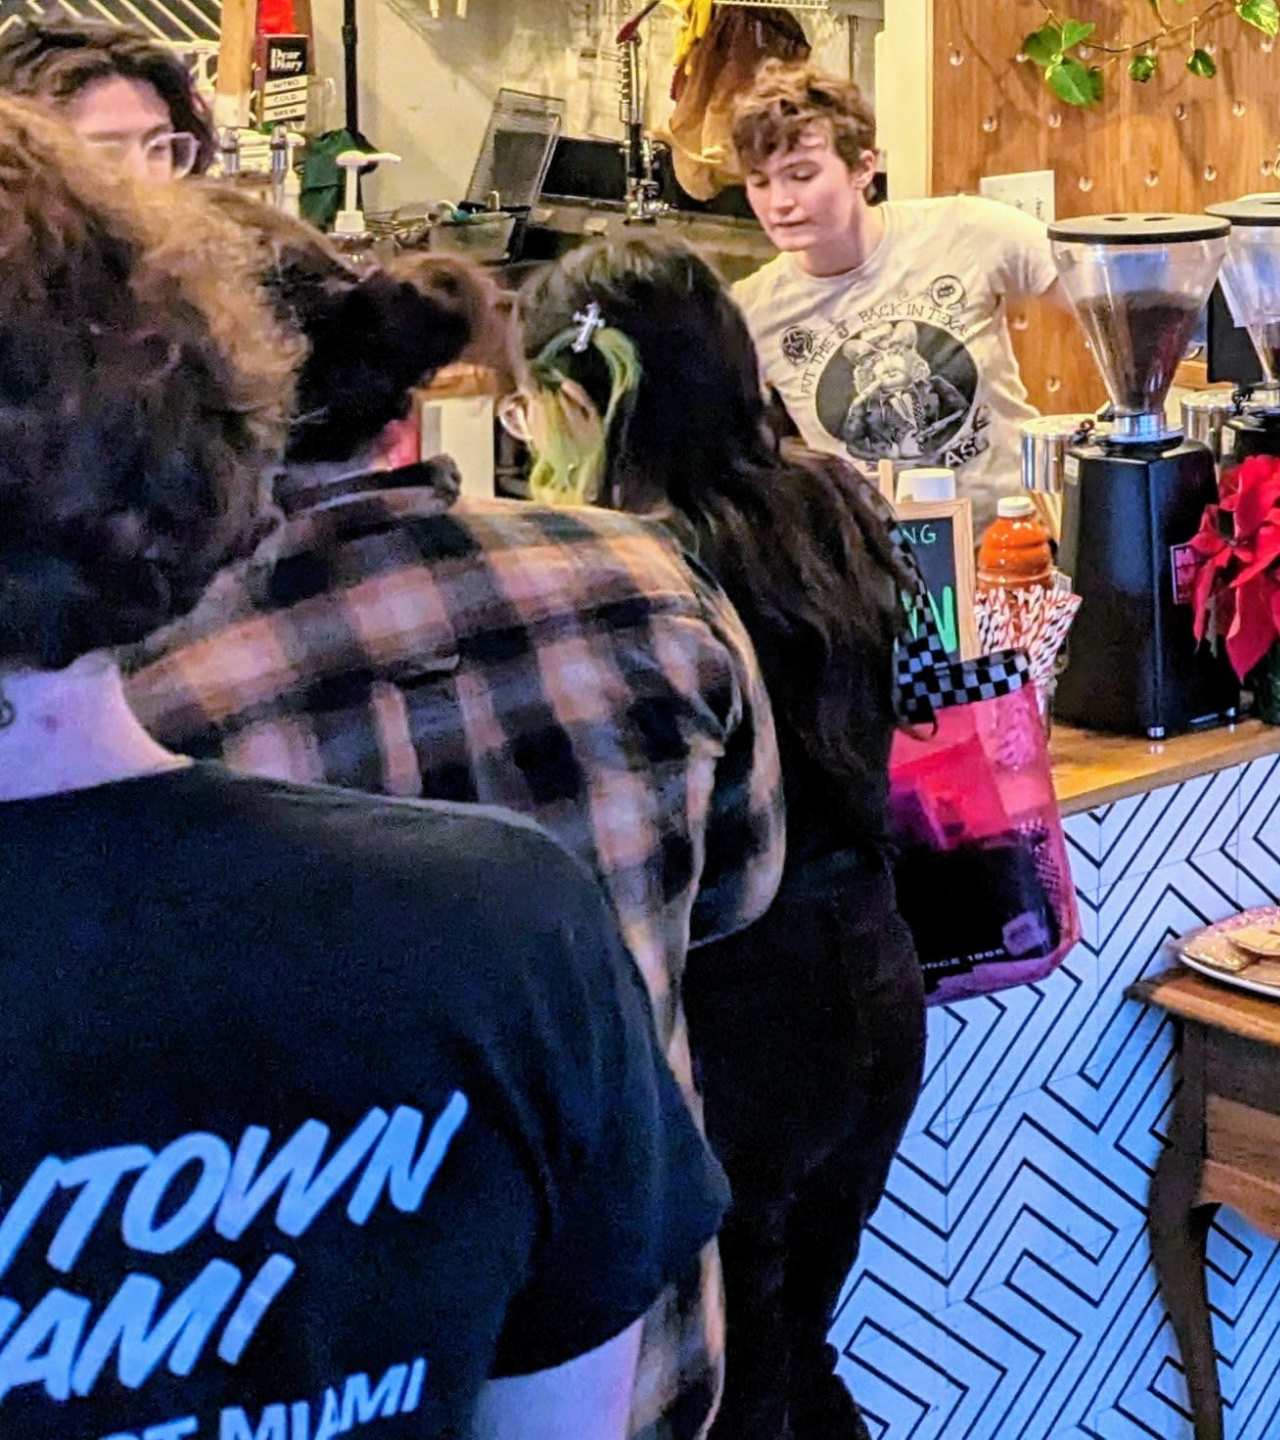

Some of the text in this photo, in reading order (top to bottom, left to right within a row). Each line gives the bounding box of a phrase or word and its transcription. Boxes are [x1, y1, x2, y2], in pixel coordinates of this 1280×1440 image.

[270, 48, 301, 61] Dear
[270, 58, 304, 72] Diary
[811, 338, 835, 366] THE
[858, 302, 901, 324] BACK
[906, 302, 924, 317] IN
[219, 1357, 427, 1440] MIAMI
